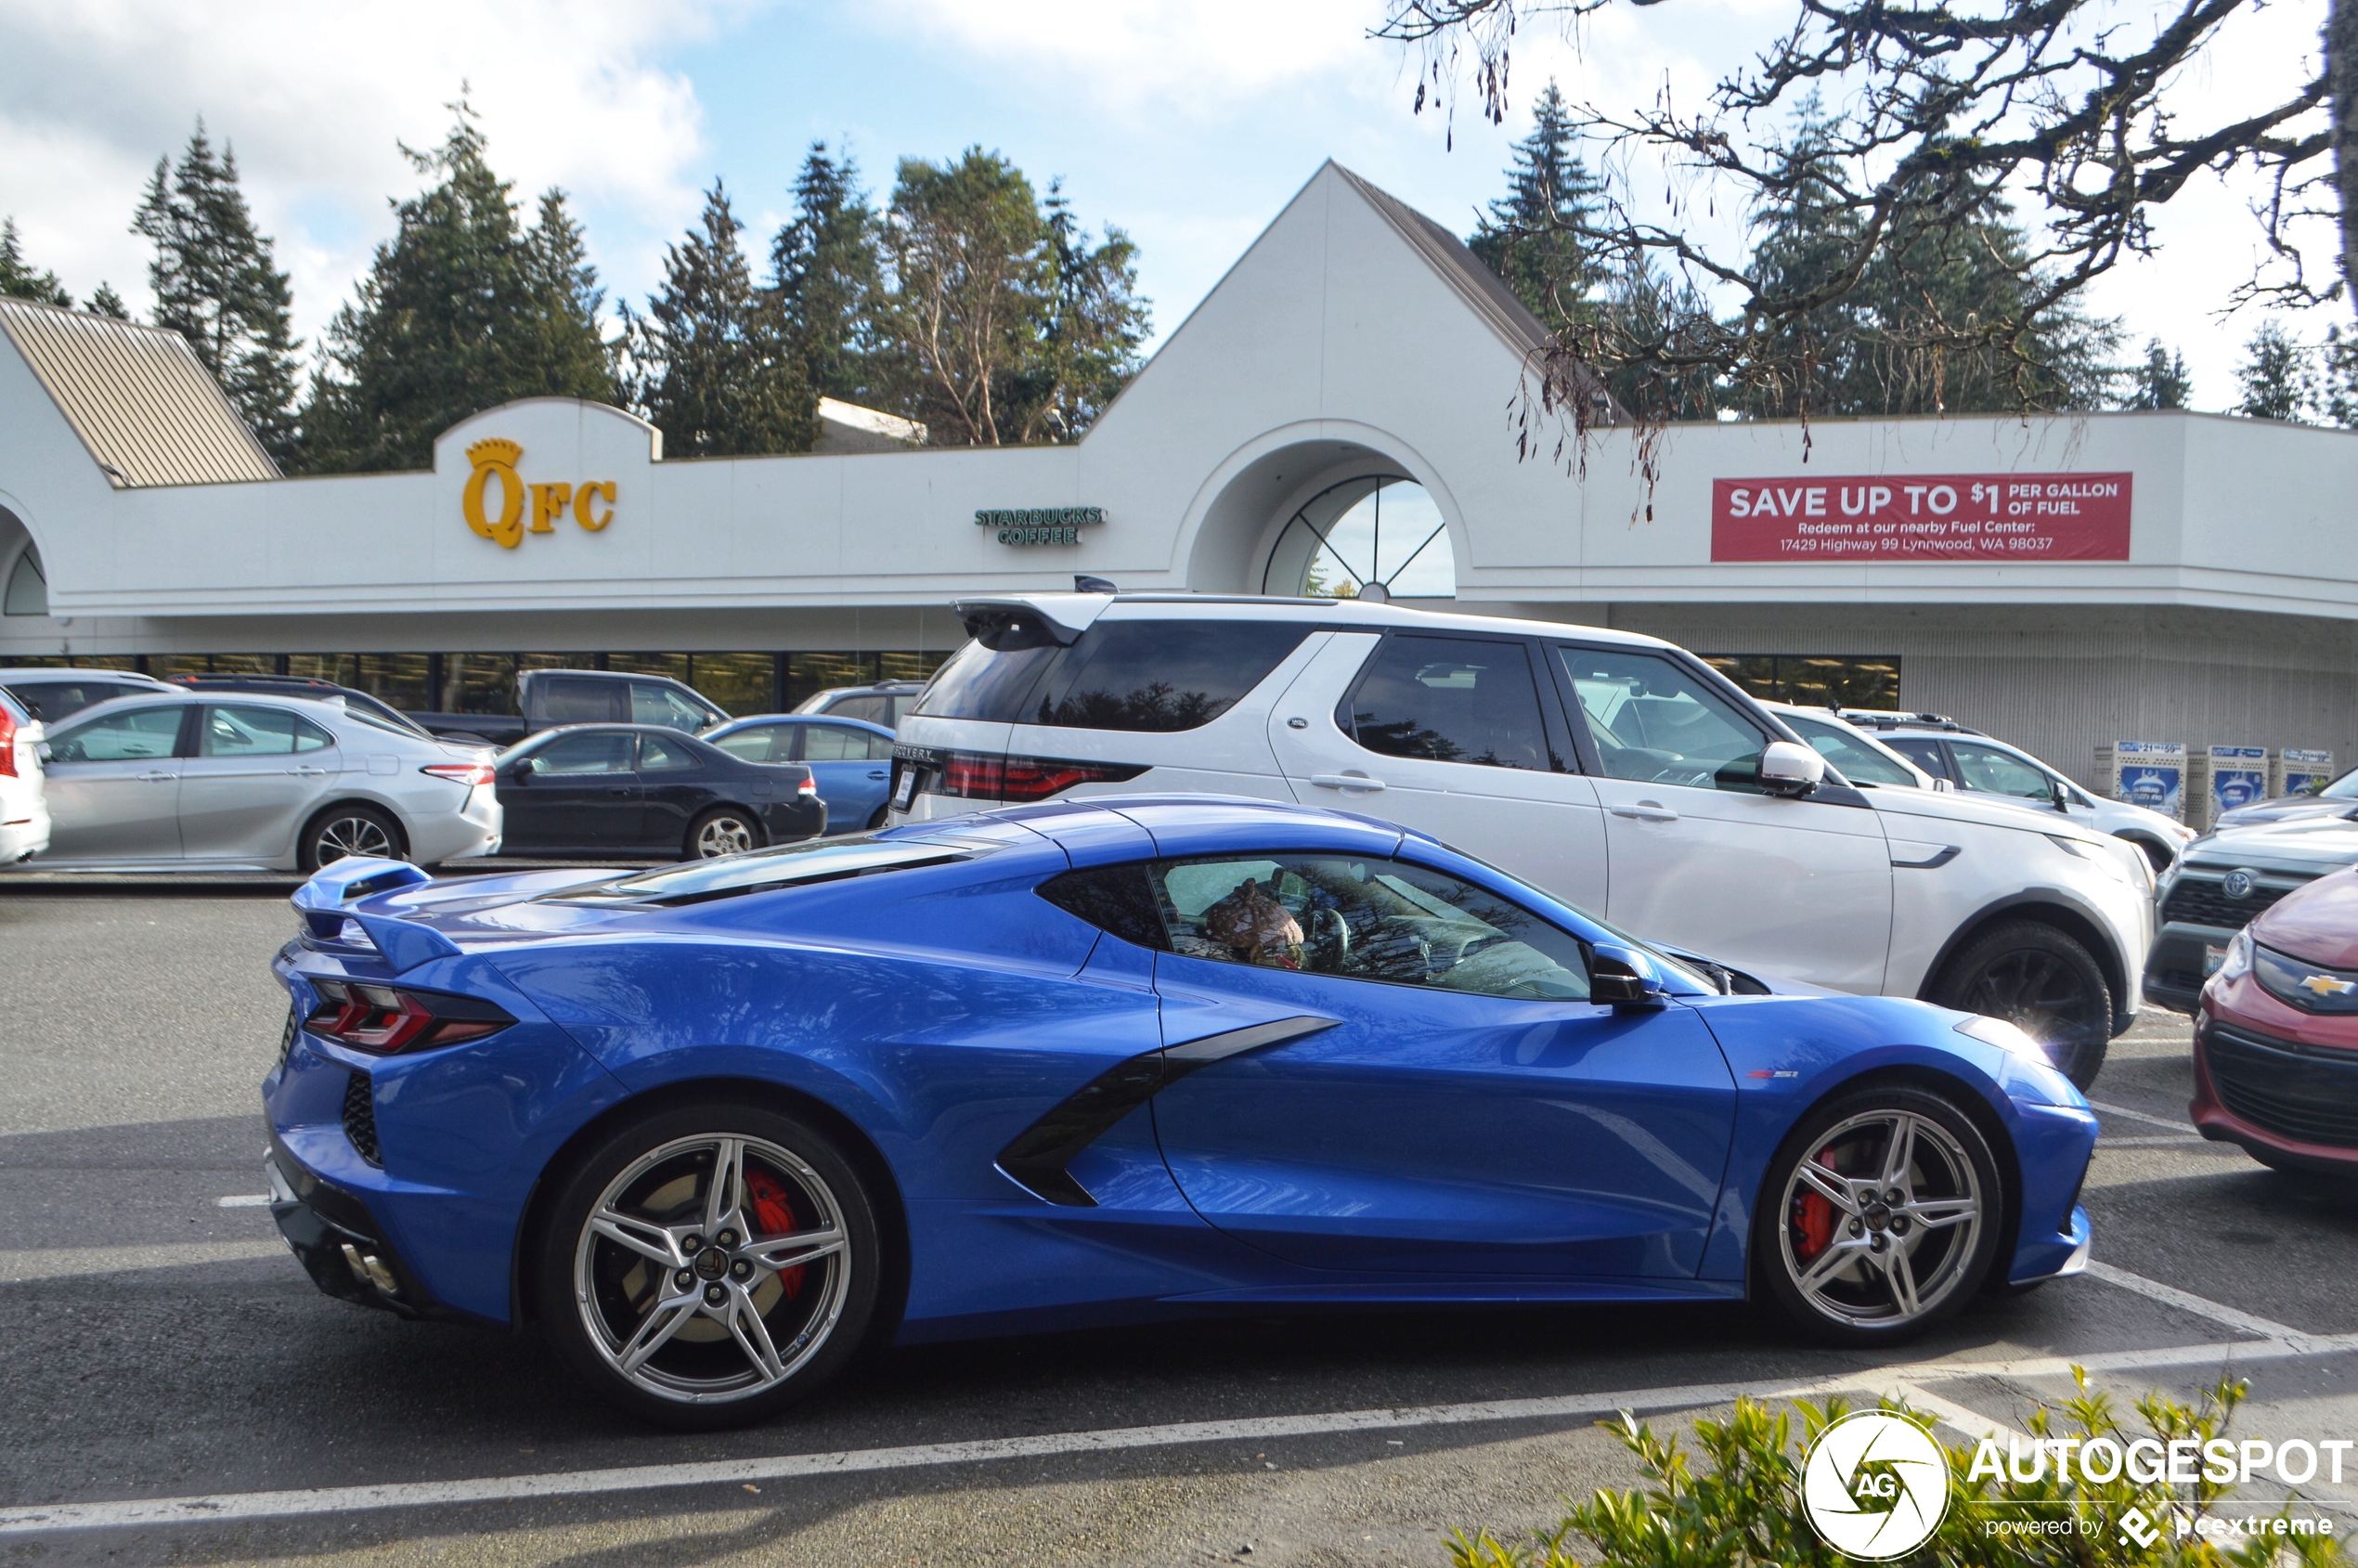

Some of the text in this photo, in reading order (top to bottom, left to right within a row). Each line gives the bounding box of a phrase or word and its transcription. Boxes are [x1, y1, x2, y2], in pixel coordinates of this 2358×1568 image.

[2008, 483, 2118, 498] PER GALLON
[462, 459, 616, 549] QFC
[1730, 482, 1999, 517] SAVE UP TO $1
[2008, 500, 2080, 515] OF FUEL
[975, 507, 1102, 526] STARBUCKS
[997, 527, 1077, 545] COFFEE
[1798, 521, 2036, 536] Redeem at our nearby Fuel Center:
[1781, 538, 2053, 552] 17429 Highway 99 Lynnwood, WA 98037
